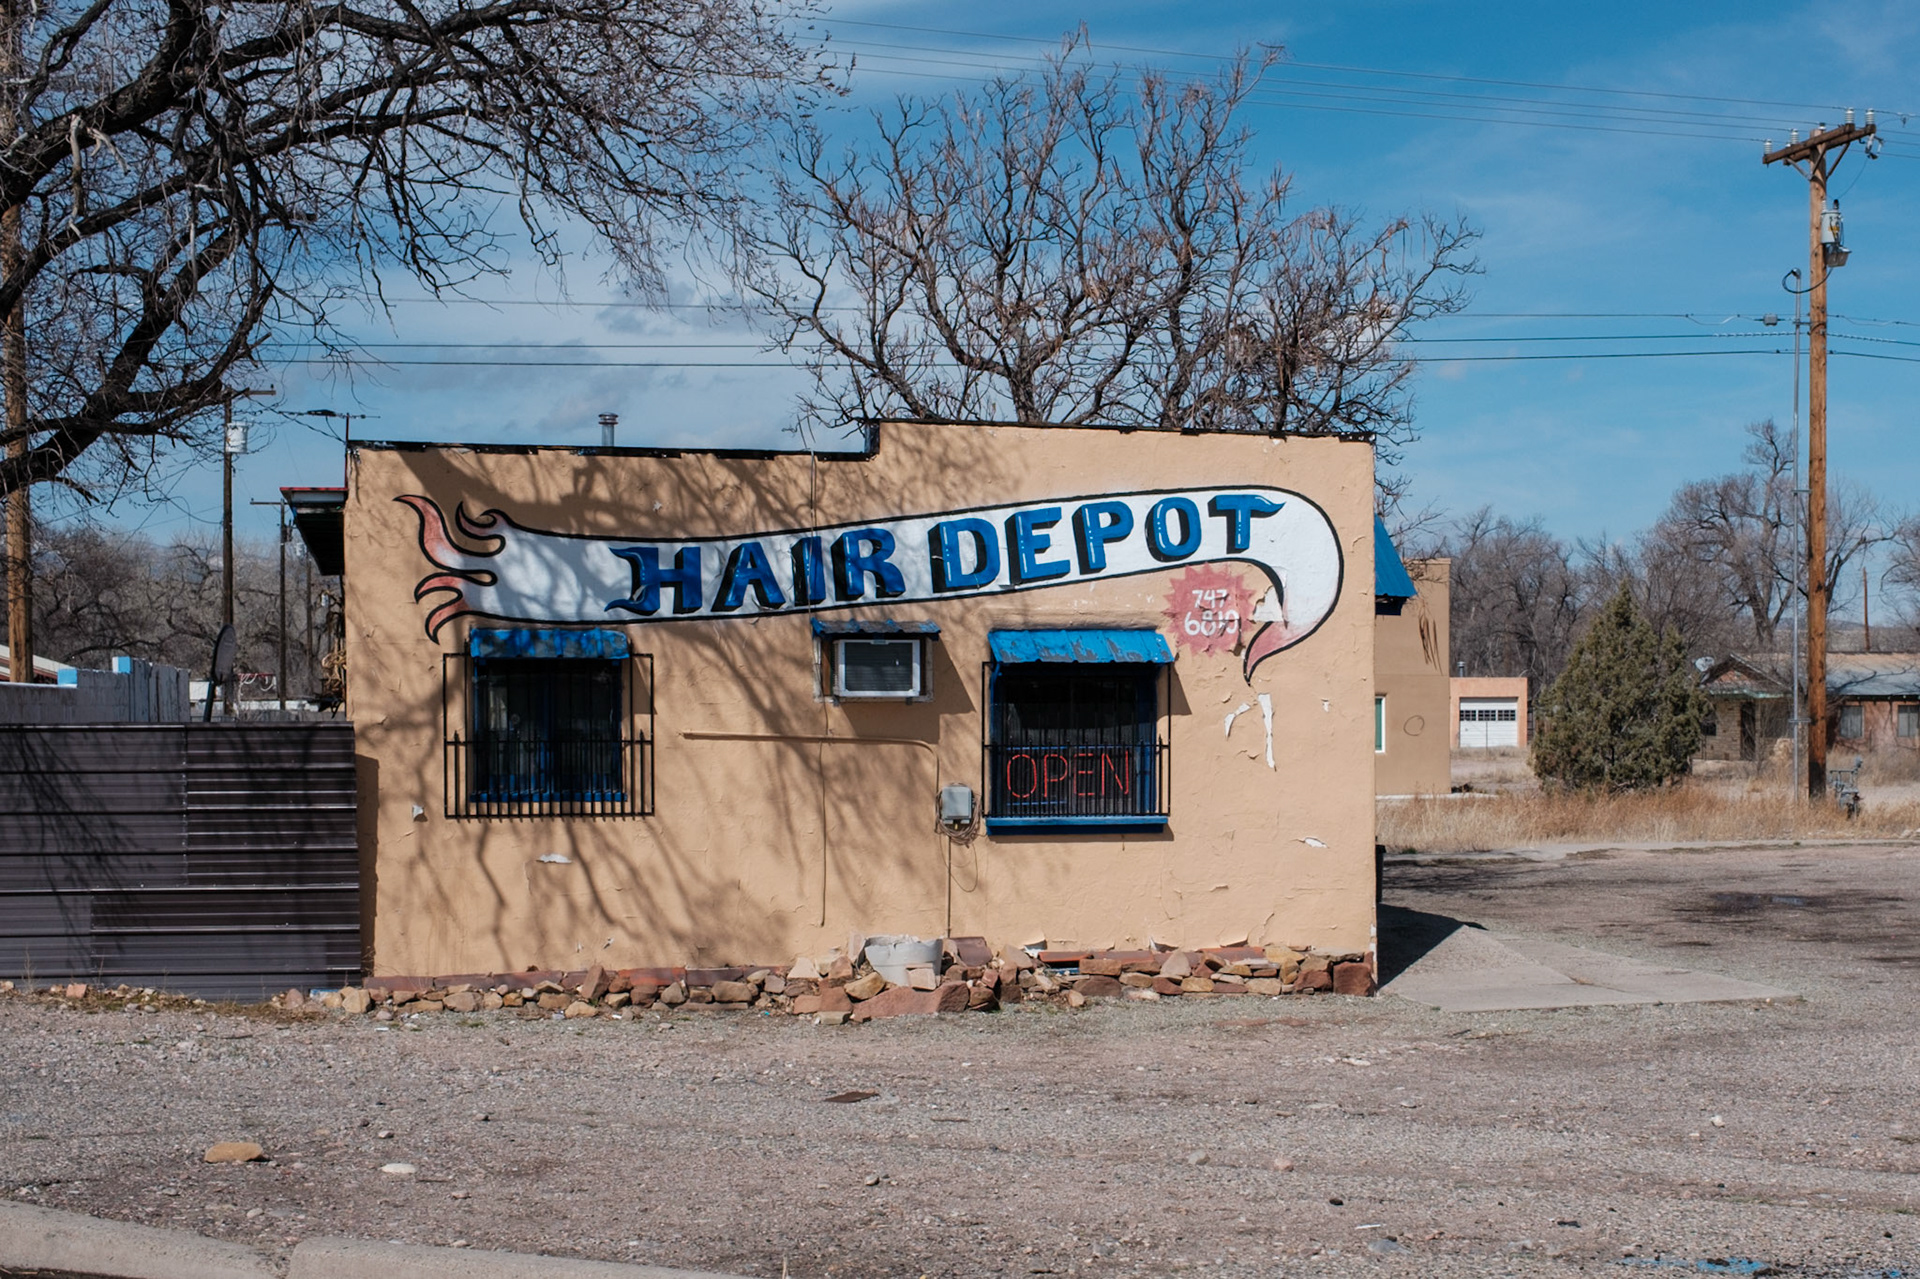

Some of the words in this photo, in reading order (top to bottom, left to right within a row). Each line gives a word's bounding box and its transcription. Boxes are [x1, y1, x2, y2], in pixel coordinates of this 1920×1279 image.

[605, 528, 906, 616] HAIR
[928, 494, 1286, 594] DEPOT
[1191, 588, 1228, 609] 747
[1006, 750, 1130, 798] OPEN
